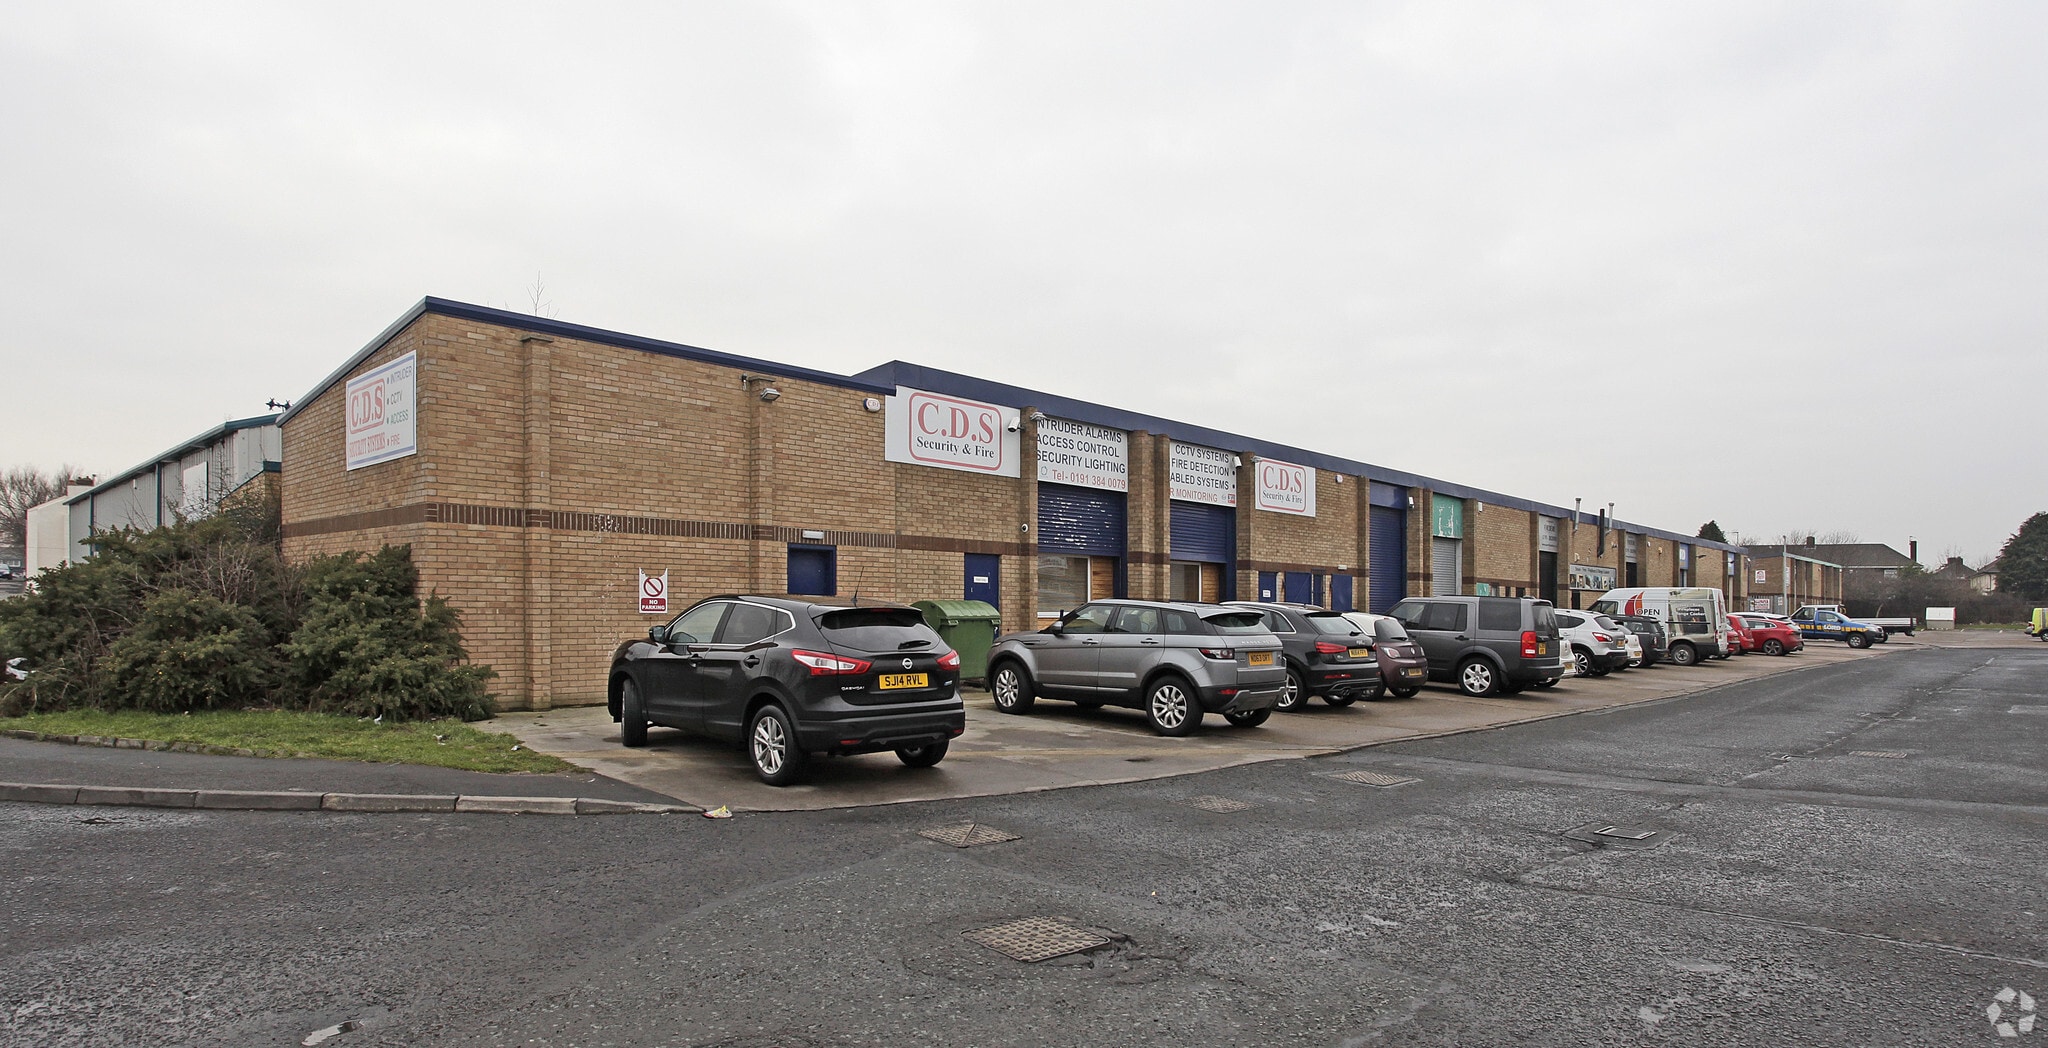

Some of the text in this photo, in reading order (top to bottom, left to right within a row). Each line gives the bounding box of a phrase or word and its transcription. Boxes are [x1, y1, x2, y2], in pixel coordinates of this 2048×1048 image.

[352, 385, 382, 427] C.D.S
[391, 389, 402, 405] CCTV
[918, 402, 993, 444] C.D.S
[1038, 418, 1121, 443] NTRUDER ALARMS
[917, 436, 994, 458] Security & Fire
[1037, 434, 1119, 457] ACCESS CONTROL
[1176, 445, 1229, 463] CCTV SYSTEMS
[1037, 449, 1125, 473] SECURITY LIGHTING
[1172, 458, 1229, 476] FIRE DETECTION
[1070, 472, 1089, 484] 0191
[1092, 475, 1105, 487] 384
[1108, 478, 1126, 489] 0079
[1197, 476, 1229, 490] SYSTEMS
[1264, 466, 1302, 493] C.D.S
[1176, 489, 1218, 502] MONITORING
[1263, 490, 1302, 503] Security & Fire
[885, 675, 923, 687] SJ14 RVL
